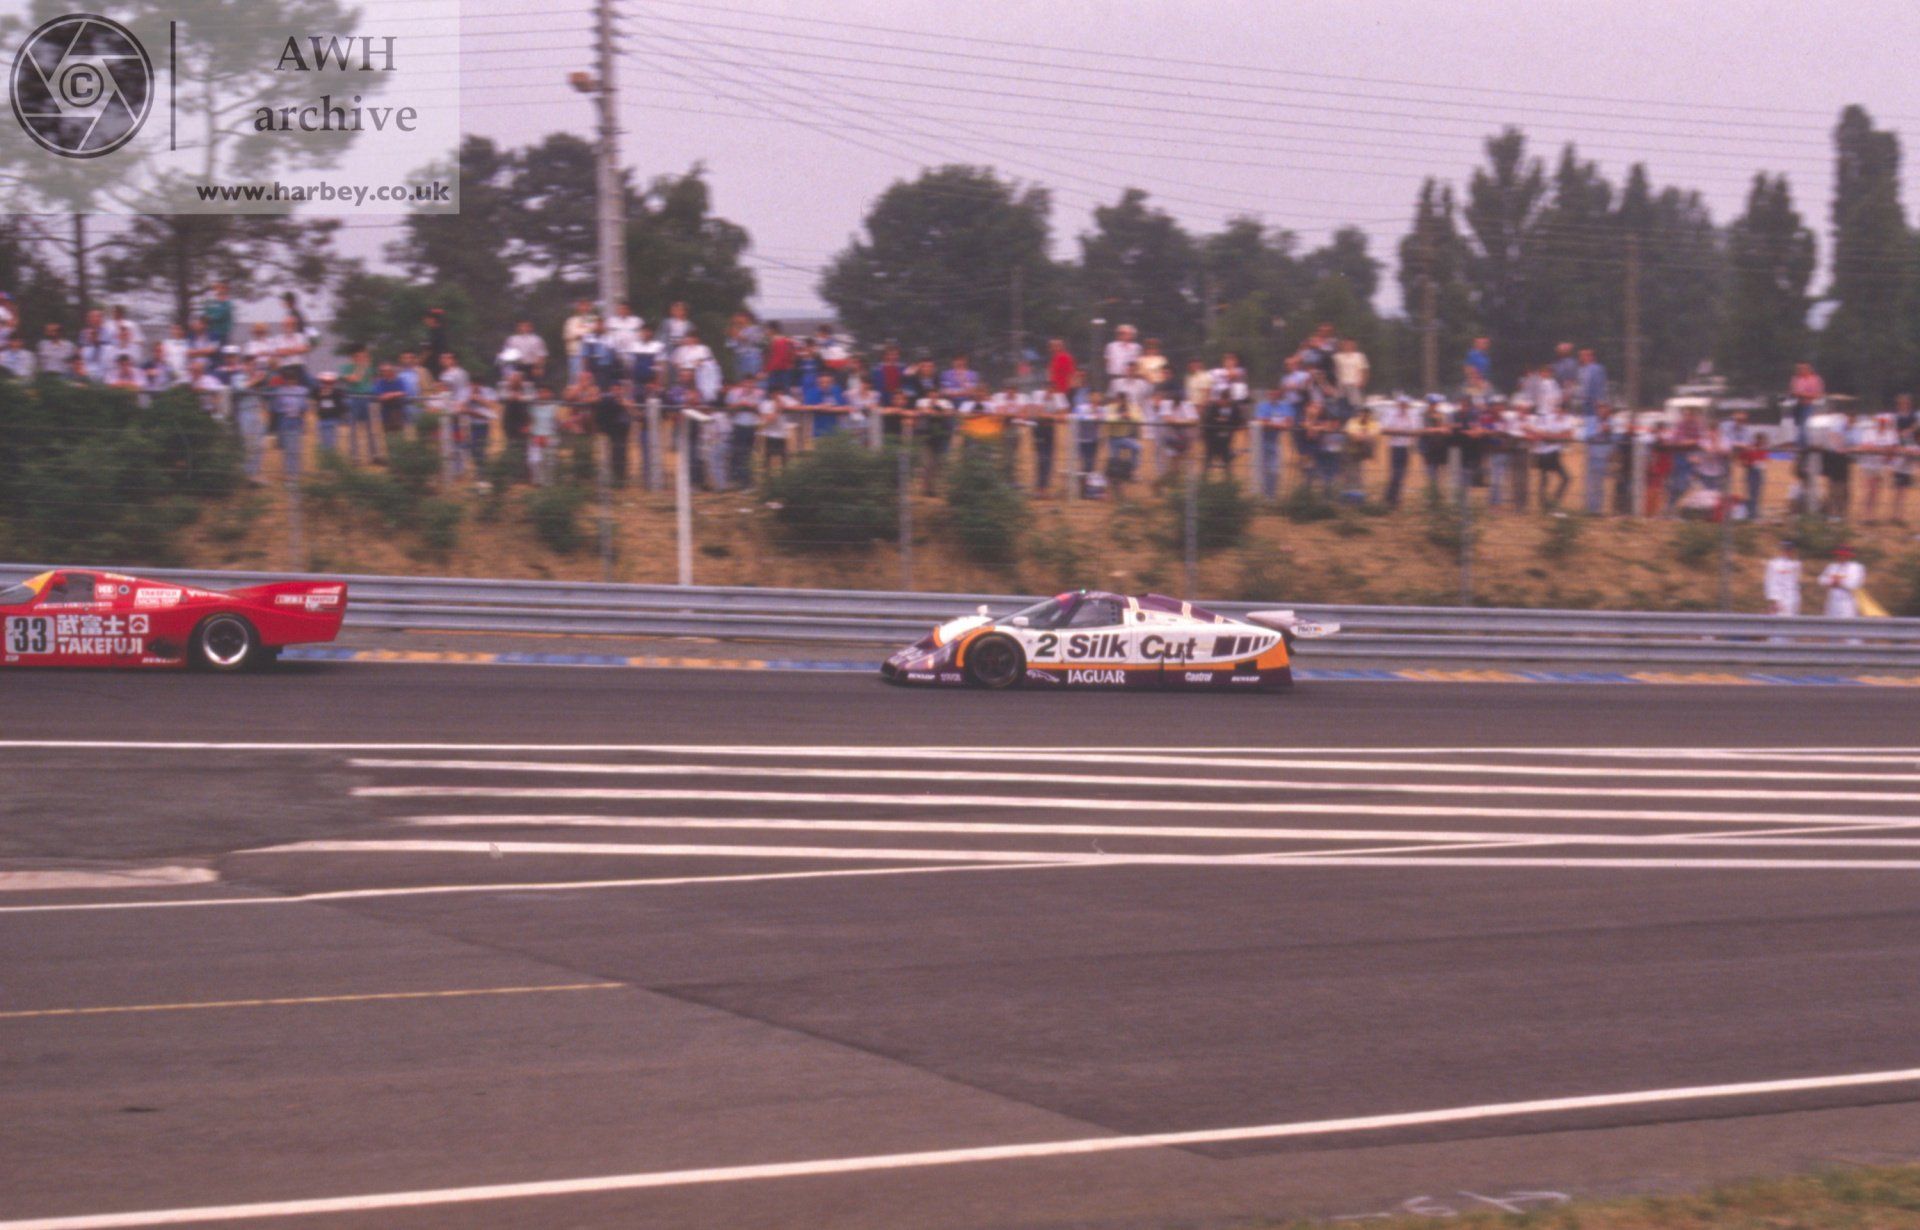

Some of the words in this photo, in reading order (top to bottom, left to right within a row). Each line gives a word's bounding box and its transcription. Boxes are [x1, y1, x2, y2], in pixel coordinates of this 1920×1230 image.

[14, 617, 47, 652] 33
[57, 614, 126, 635] 武富士
[57, 638, 142, 654] TAKEFUJI
[1035, 633, 1058, 657] 2
[1067, 634, 1128, 658] Silk
[1140, 635, 1197, 659] Cut
[1067, 670, 1126, 684] JAGUAR
[1185, 672, 1213, 682] Castrol
